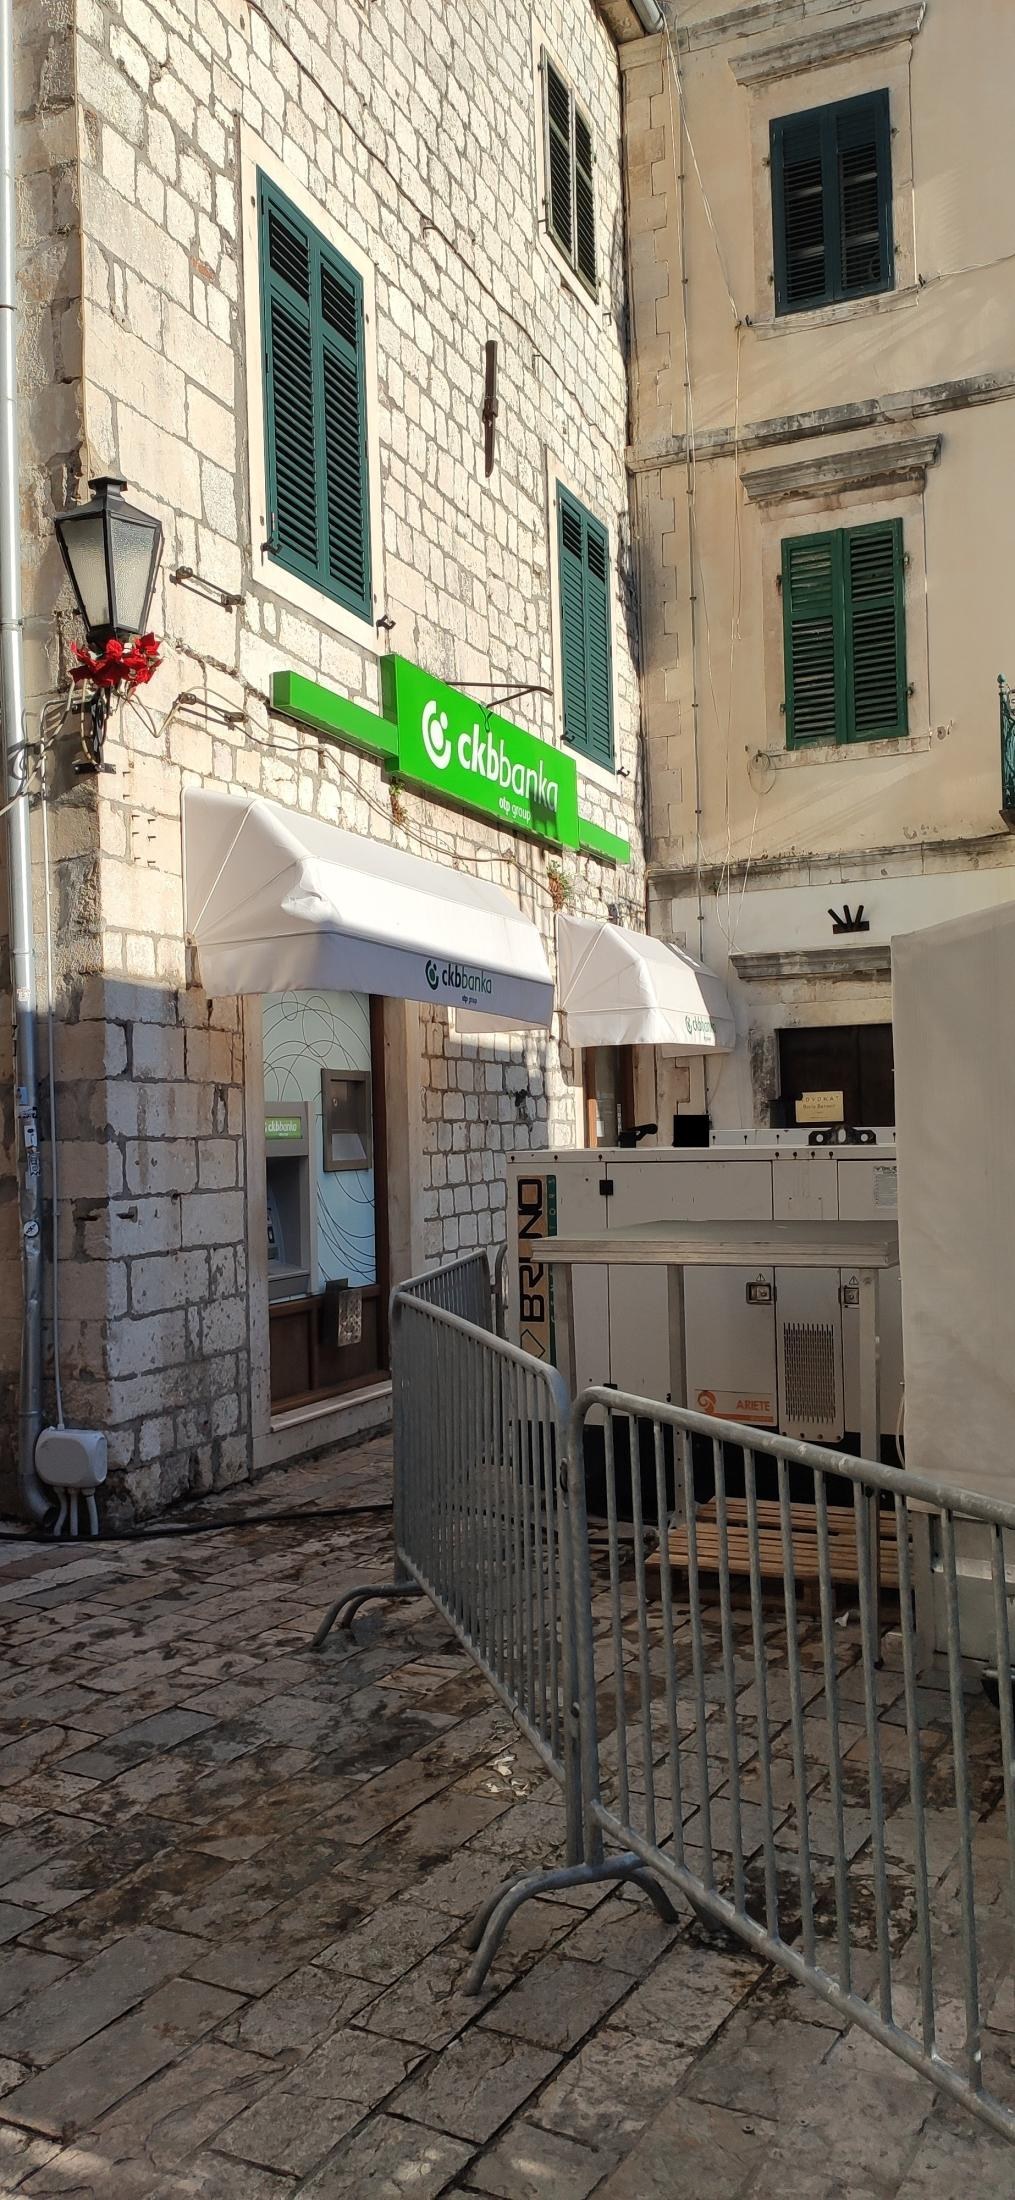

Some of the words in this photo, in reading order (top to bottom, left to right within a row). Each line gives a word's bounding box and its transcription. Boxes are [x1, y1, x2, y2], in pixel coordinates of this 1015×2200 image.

[457, 723, 559, 813] ckbbanka
[499, 796, 511, 815] otp
[511, 803, 531, 823] group
[441, 963, 492, 994] ckbbanka
[736, 1400, 771, 1412] ARIETE
